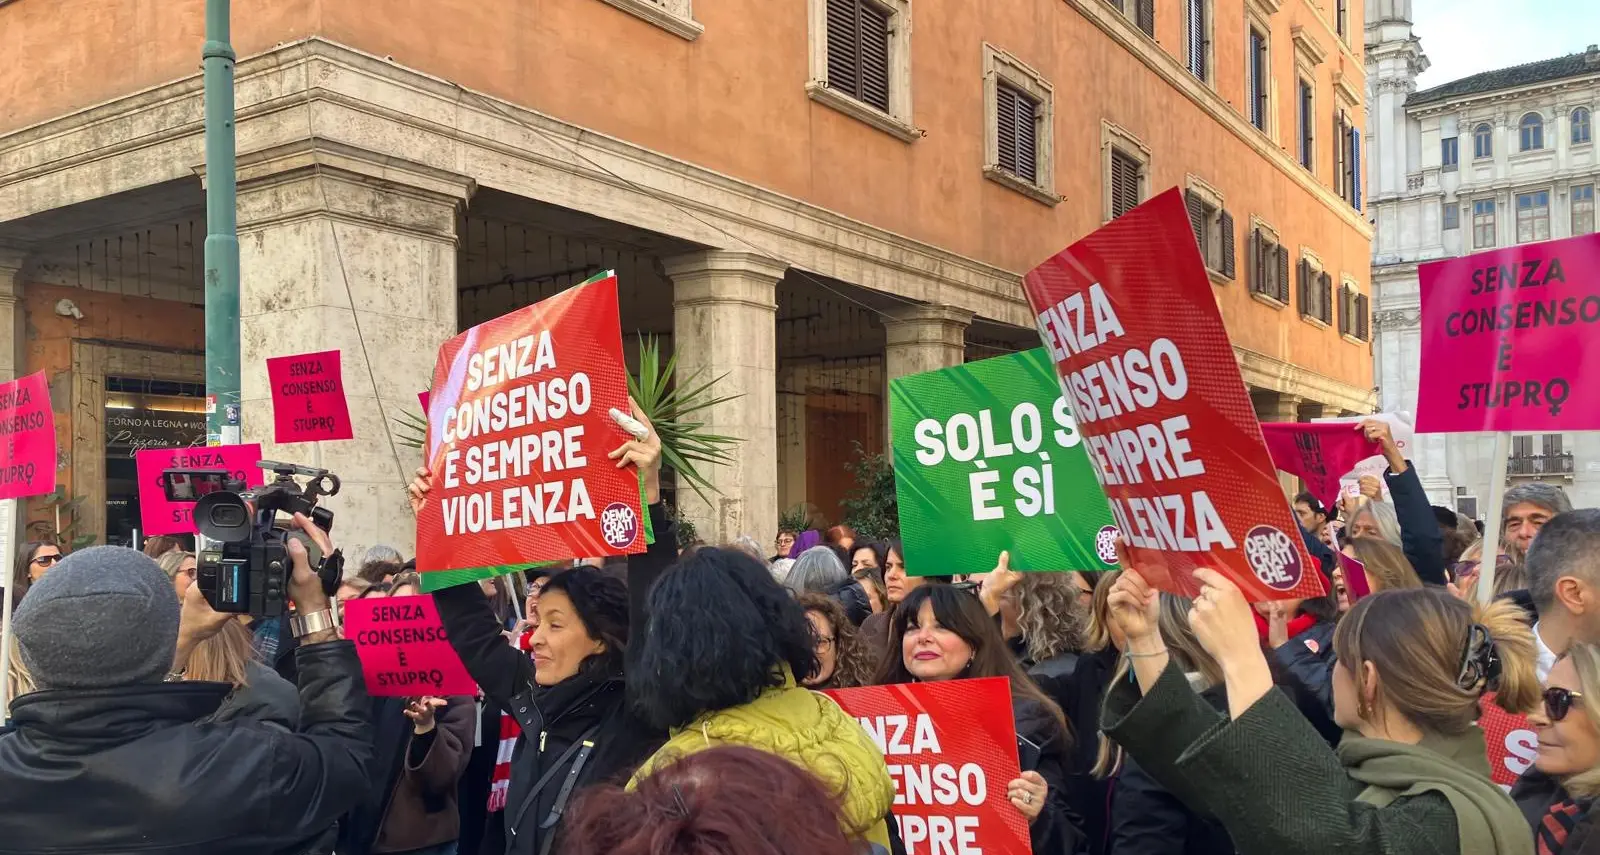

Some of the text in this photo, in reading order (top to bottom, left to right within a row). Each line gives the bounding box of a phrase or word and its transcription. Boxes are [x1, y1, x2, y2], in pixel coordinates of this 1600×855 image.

[1471, 258, 1565, 295] SENZA
[1037, 282, 1125, 364] ENZA
[1445, 295, 1600, 337] CONSENSO
[290, 361, 324, 377] SENZA
[466, 329, 557, 392] SENZA
[1497, 336, 1512, 371] È
[281, 379, 336, 397] CONSENSO
[1458, 377, 1570, 417] STUPRO
[108, 417, 142, 427] FORNO
[143, 419, 151, 428] A
[153, 420, 183, 429] LEGNA
[441, 372, 592, 444] CONSENSO
[108, 430, 168, 458] Pizzeria
[914, 395, 1082, 466] SOLO S
[170, 453, 225, 469] SENZA
[444, 425, 588, 490] È SEMPRE
[968, 451, 1055, 521] È SÌ
[441, 477, 596, 536] VIOLENZA
[602, 507, 634, 523] DEMO
[603, 518, 633, 533] CRATI
[1245, 531, 1291, 554] DEMO
[1251, 547, 1295, 569] CRATI
[371, 604, 425, 623] SENZA
[357, 626, 448, 646] CONSENSO
[857, 713, 942, 755] NZA
[898, 815, 983, 855] PRE
